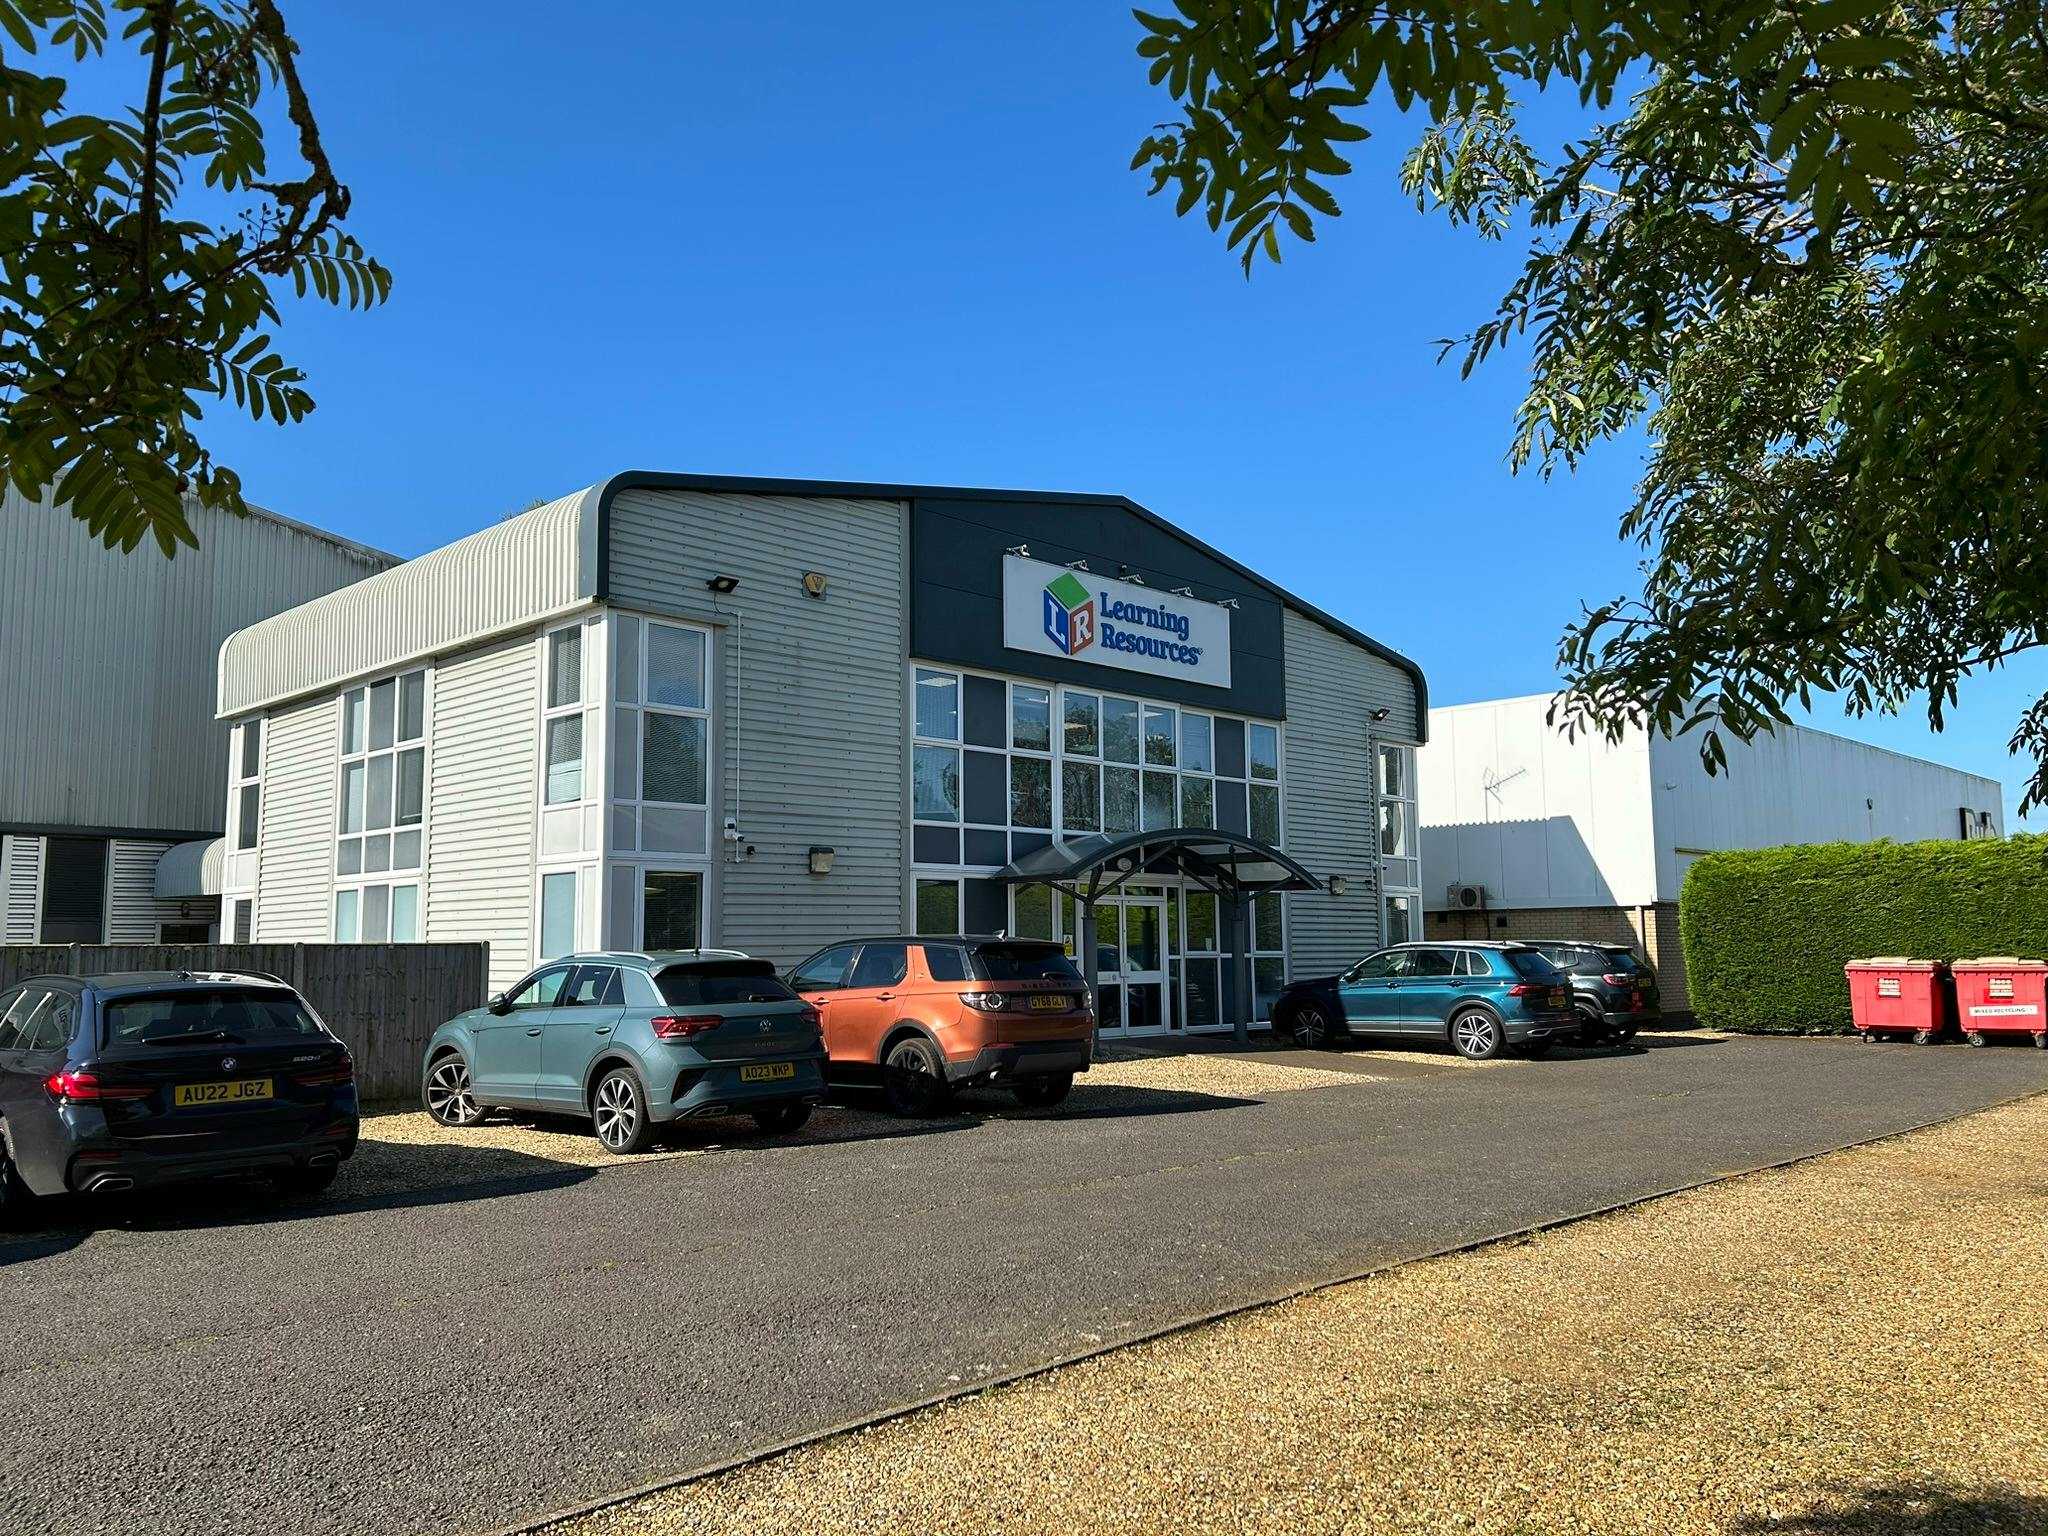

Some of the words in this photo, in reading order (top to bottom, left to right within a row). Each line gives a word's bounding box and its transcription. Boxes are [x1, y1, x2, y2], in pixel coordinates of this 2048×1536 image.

[1100, 591, 1190, 641] Learning
[771, 1063, 790, 1077] WKP
[182, 1084, 228, 1103] AU22
[233, 1081, 266, 1099] JGZ
